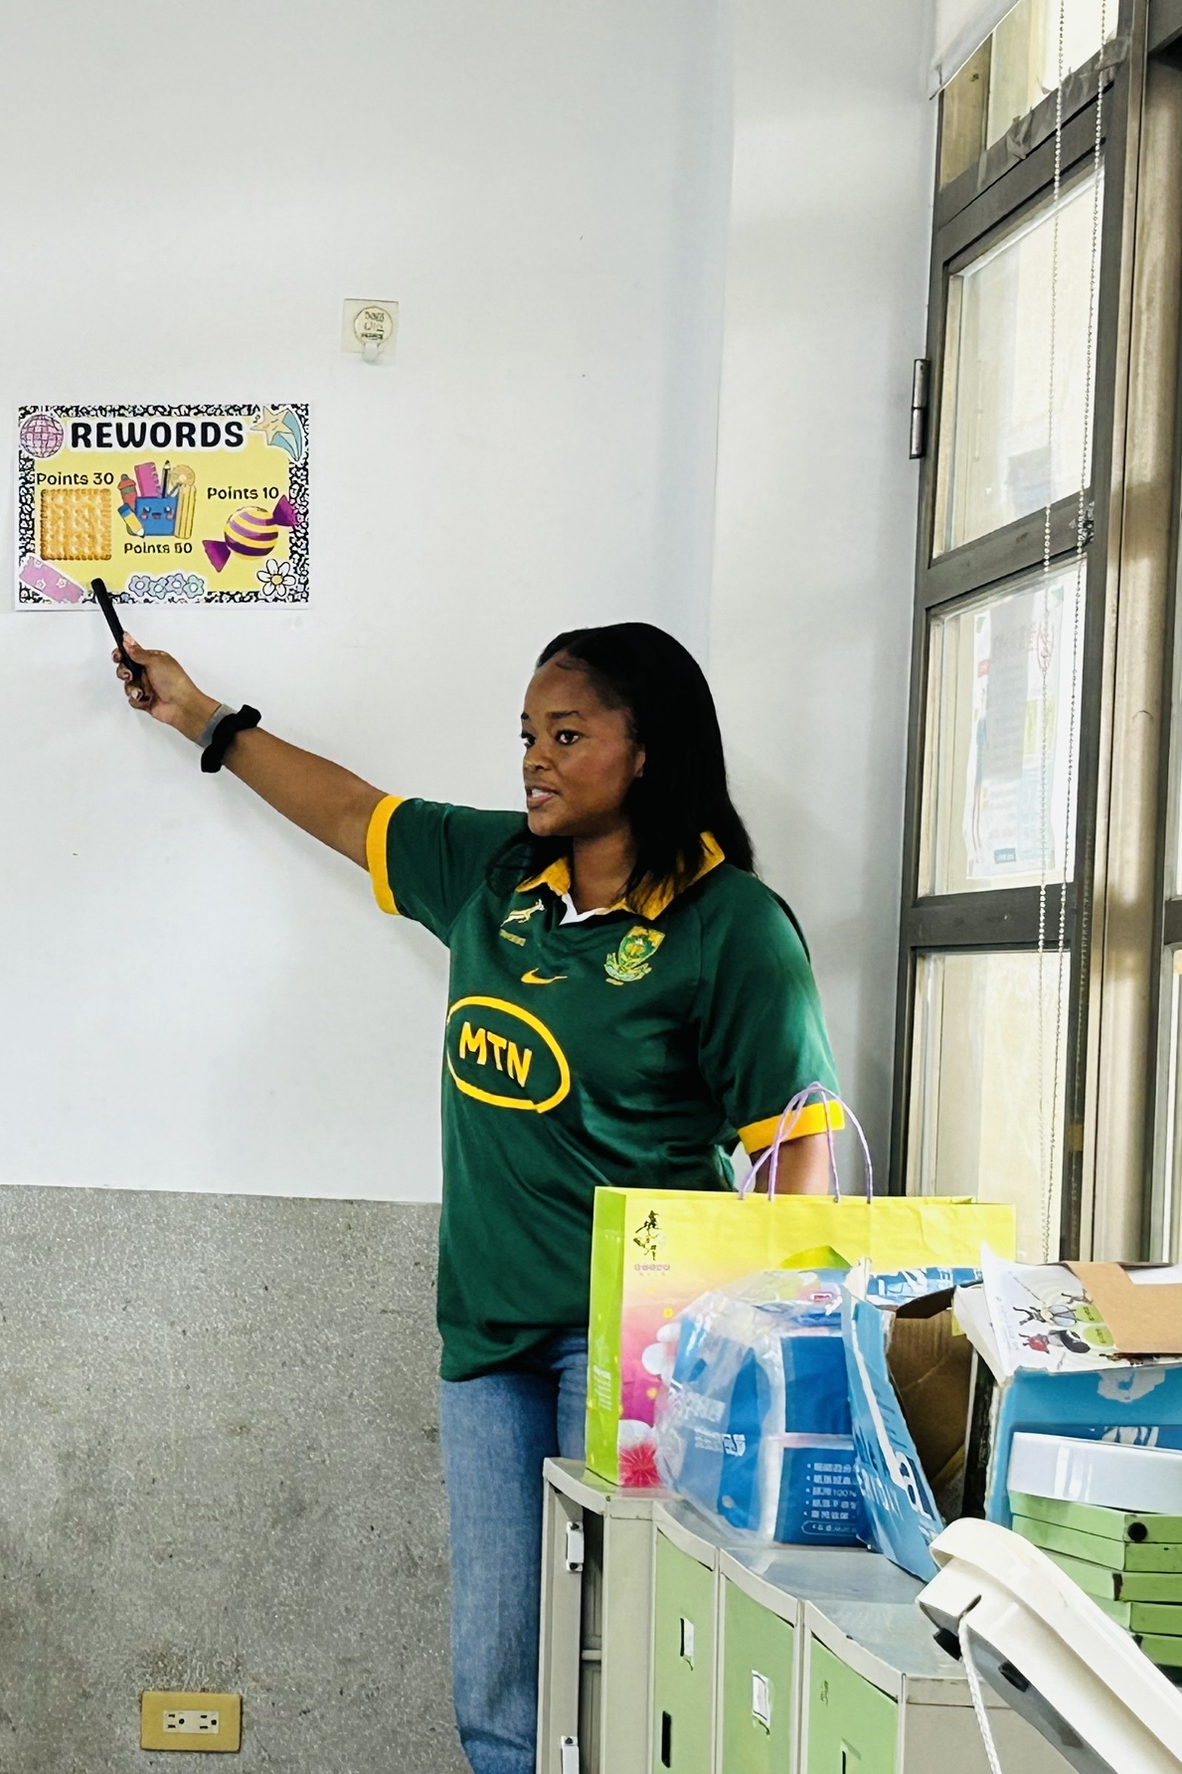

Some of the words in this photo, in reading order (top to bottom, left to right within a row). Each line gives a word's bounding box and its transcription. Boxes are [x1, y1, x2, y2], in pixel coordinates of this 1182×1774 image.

[71, 421, 245, 448] REWORDS
[36, 471, 89, 485] Points
[93, 472, 115, 485] 30
[207, 486, 259, 501] Points
[263, 487, 280, 499] 10
[124, 542, 170, 554] Points
[459, 1021, 533, 1088] MTN
